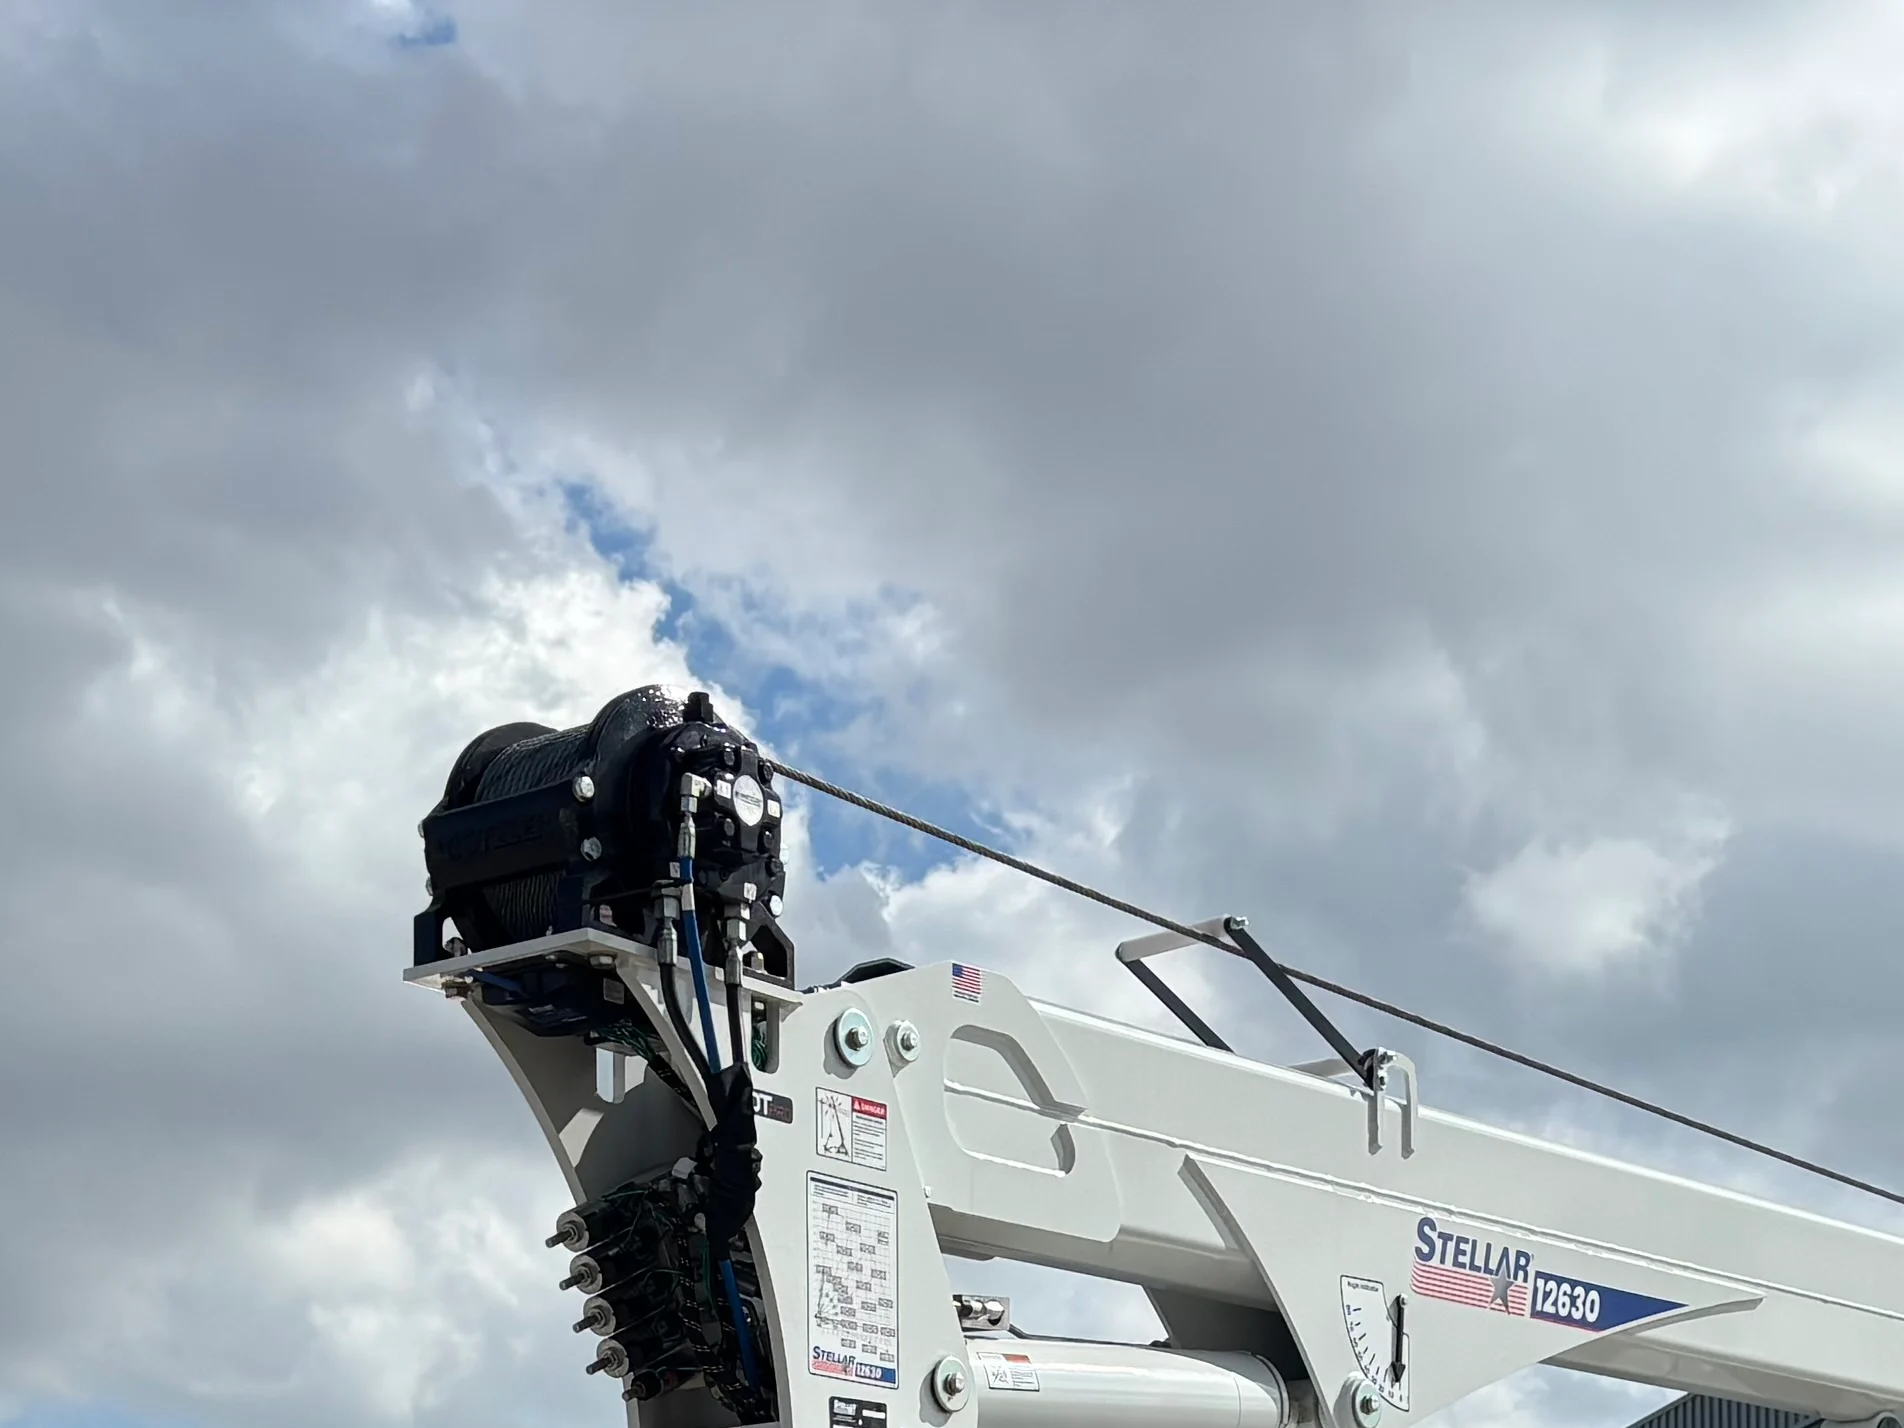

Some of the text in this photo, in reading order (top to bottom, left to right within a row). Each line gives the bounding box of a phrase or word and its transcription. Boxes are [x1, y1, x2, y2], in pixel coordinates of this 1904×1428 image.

[1414, 1216, 1601, 1323] STELLAR 12630
[812, 1345, 883, 1379] STELLAR 12630
